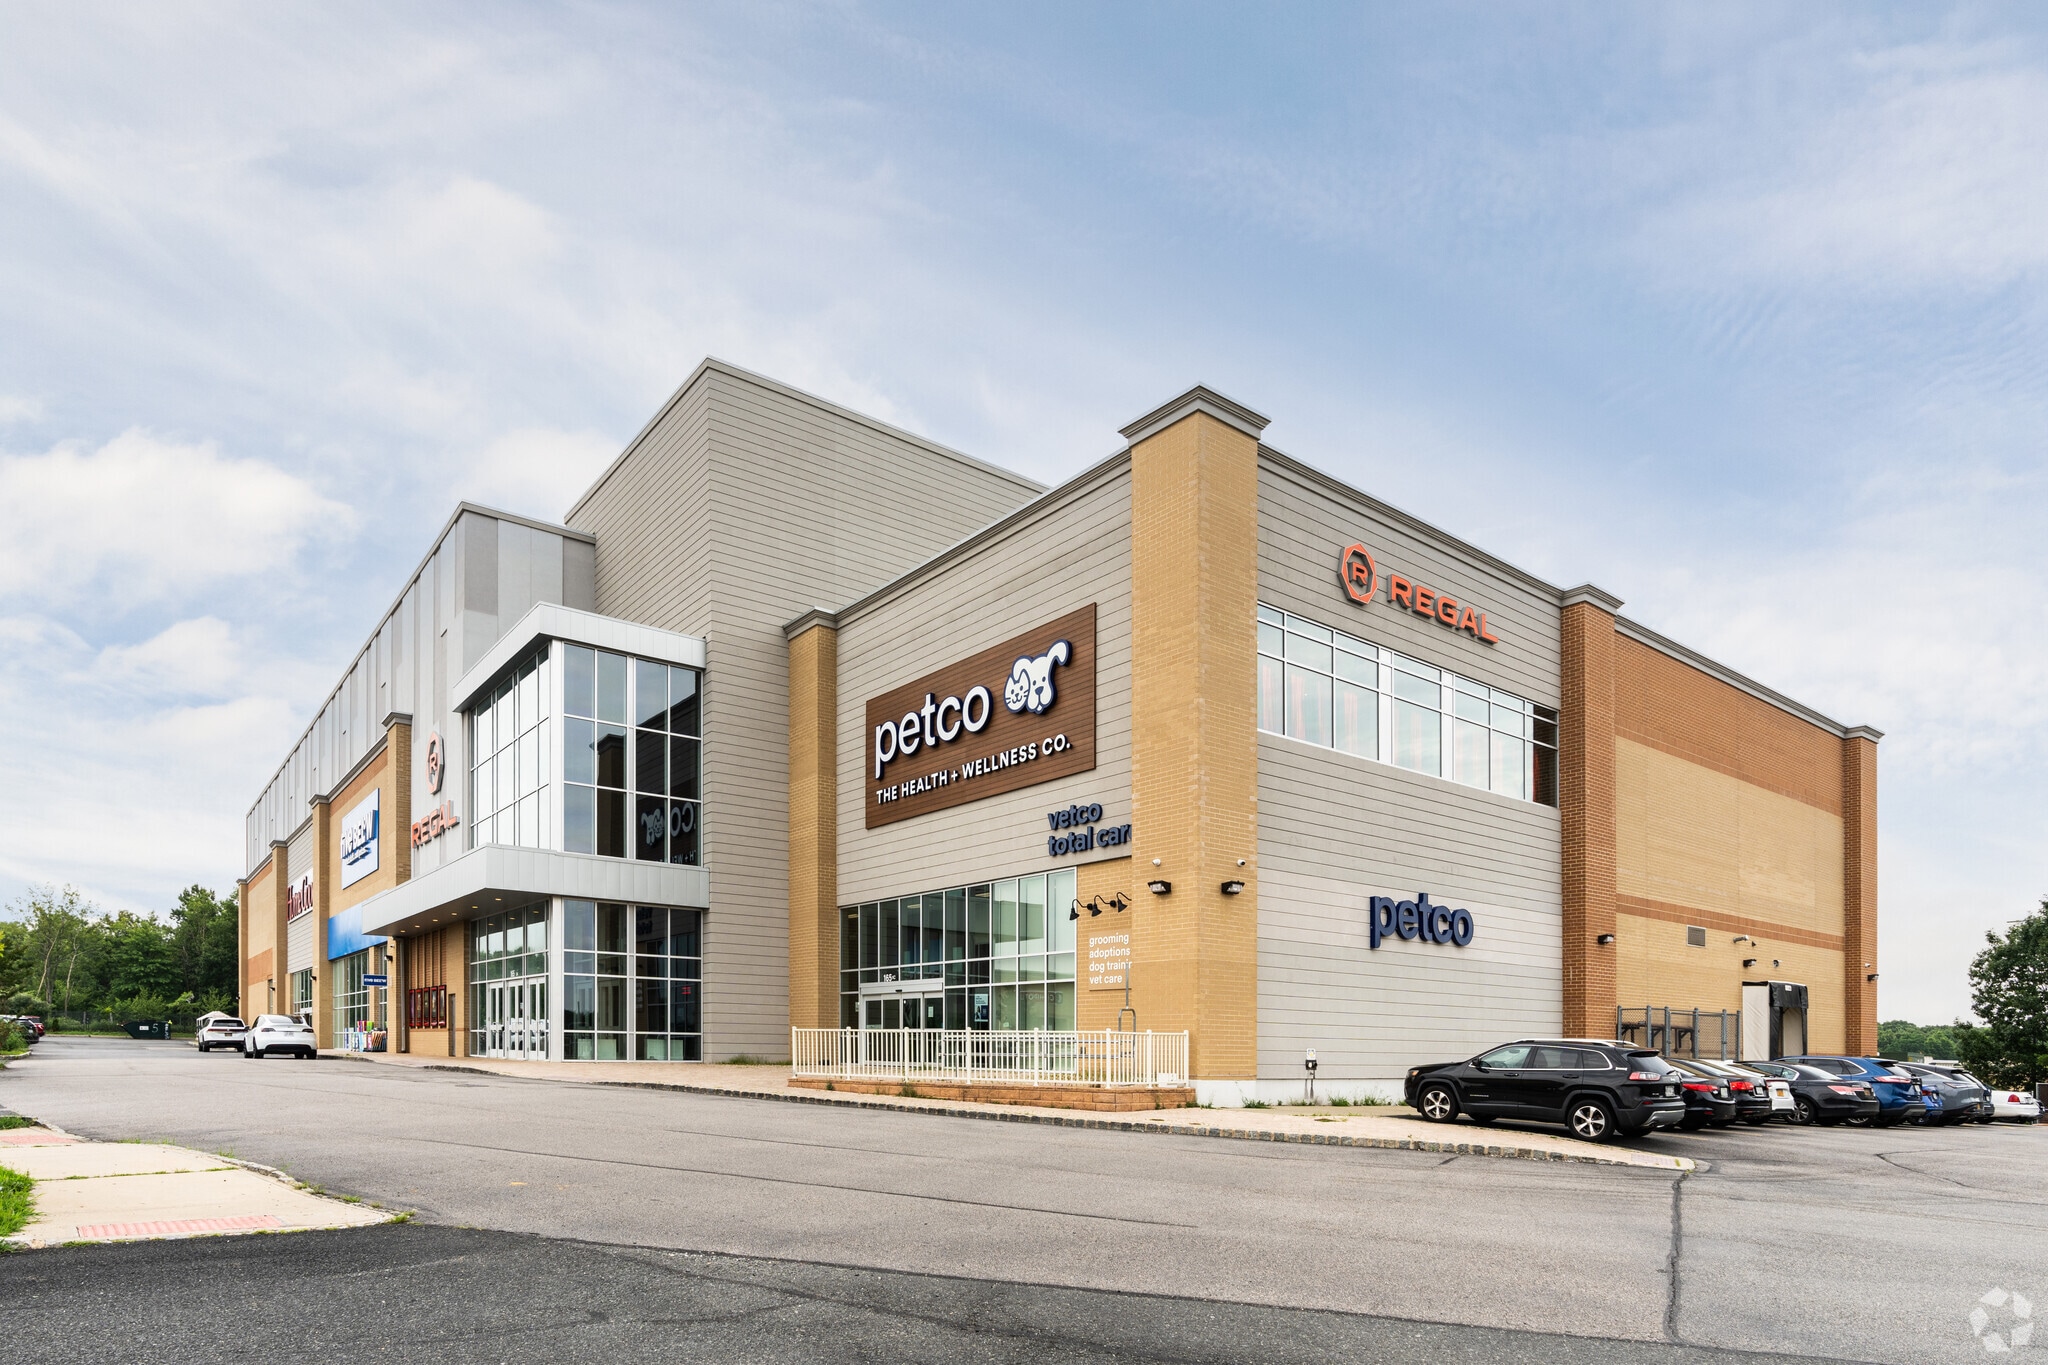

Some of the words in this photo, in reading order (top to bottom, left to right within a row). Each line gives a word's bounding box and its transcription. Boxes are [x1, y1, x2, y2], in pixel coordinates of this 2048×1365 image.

[1349, 561, 1369, 586] R
[1387, 574, 1499, 645] REGAL
[875, 685, 993, 780] petco
[876, 785, 898, 804] THE
[901, 770, 949, 798] HEALTH
[951, 770, 959, 782] +
[962, 742, 1038, 779] WELLNESS
[1042, 734, 1072, 756] CO.
[411, 800, 458, 849] REGAL
[1047, 803, 1102, 830] vetco
[1047, 826, 1094, 857] total
[1369, 893, 1474, 949] petco
[1089, 932, 1129, 948] grooming
[1089, 946, 1131, 960] adoptions
[1089, 960, 1105, 974] dog
[1090, 974, 1102, 984] vet
[1104, 975, 1123, 984] care
